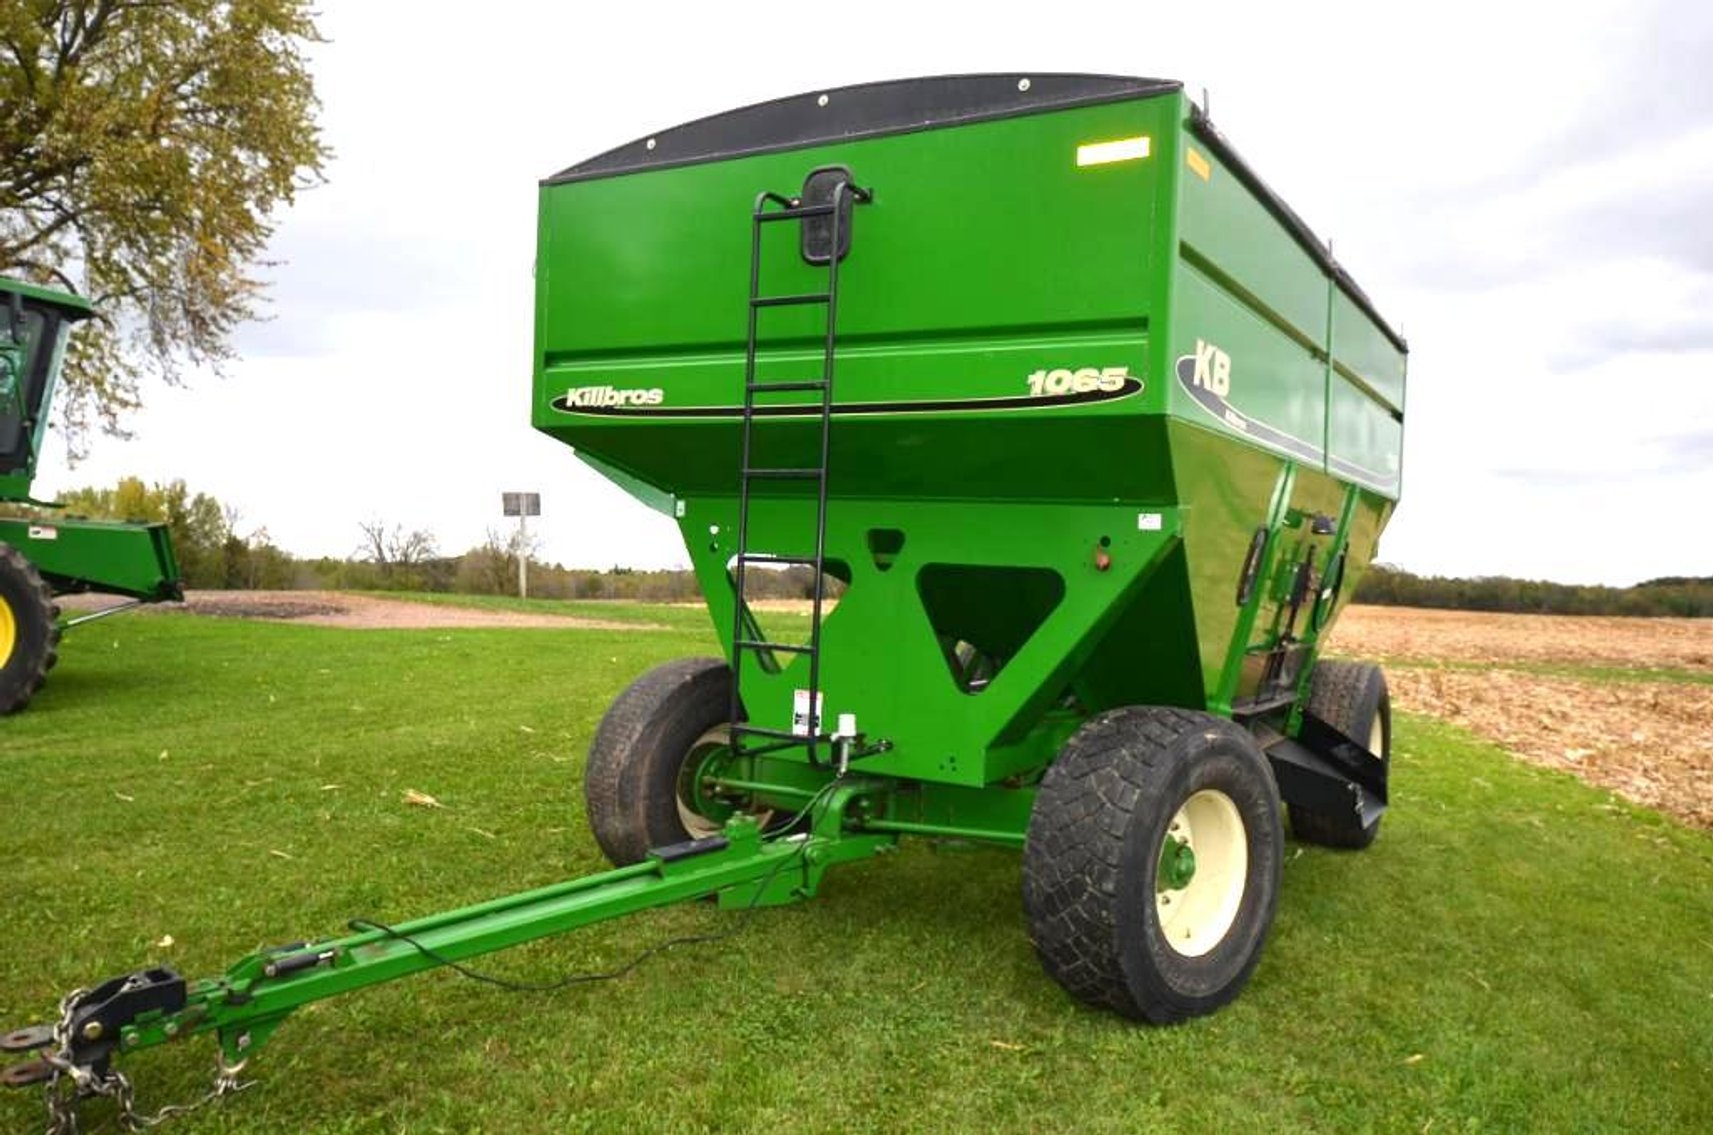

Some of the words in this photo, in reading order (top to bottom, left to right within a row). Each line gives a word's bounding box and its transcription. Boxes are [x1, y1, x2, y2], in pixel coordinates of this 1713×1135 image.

[1028, 366, 1129, 397] 1065
[1193, 338, 1231, 397] KB
[566, 386, 664, 407] Killbros
